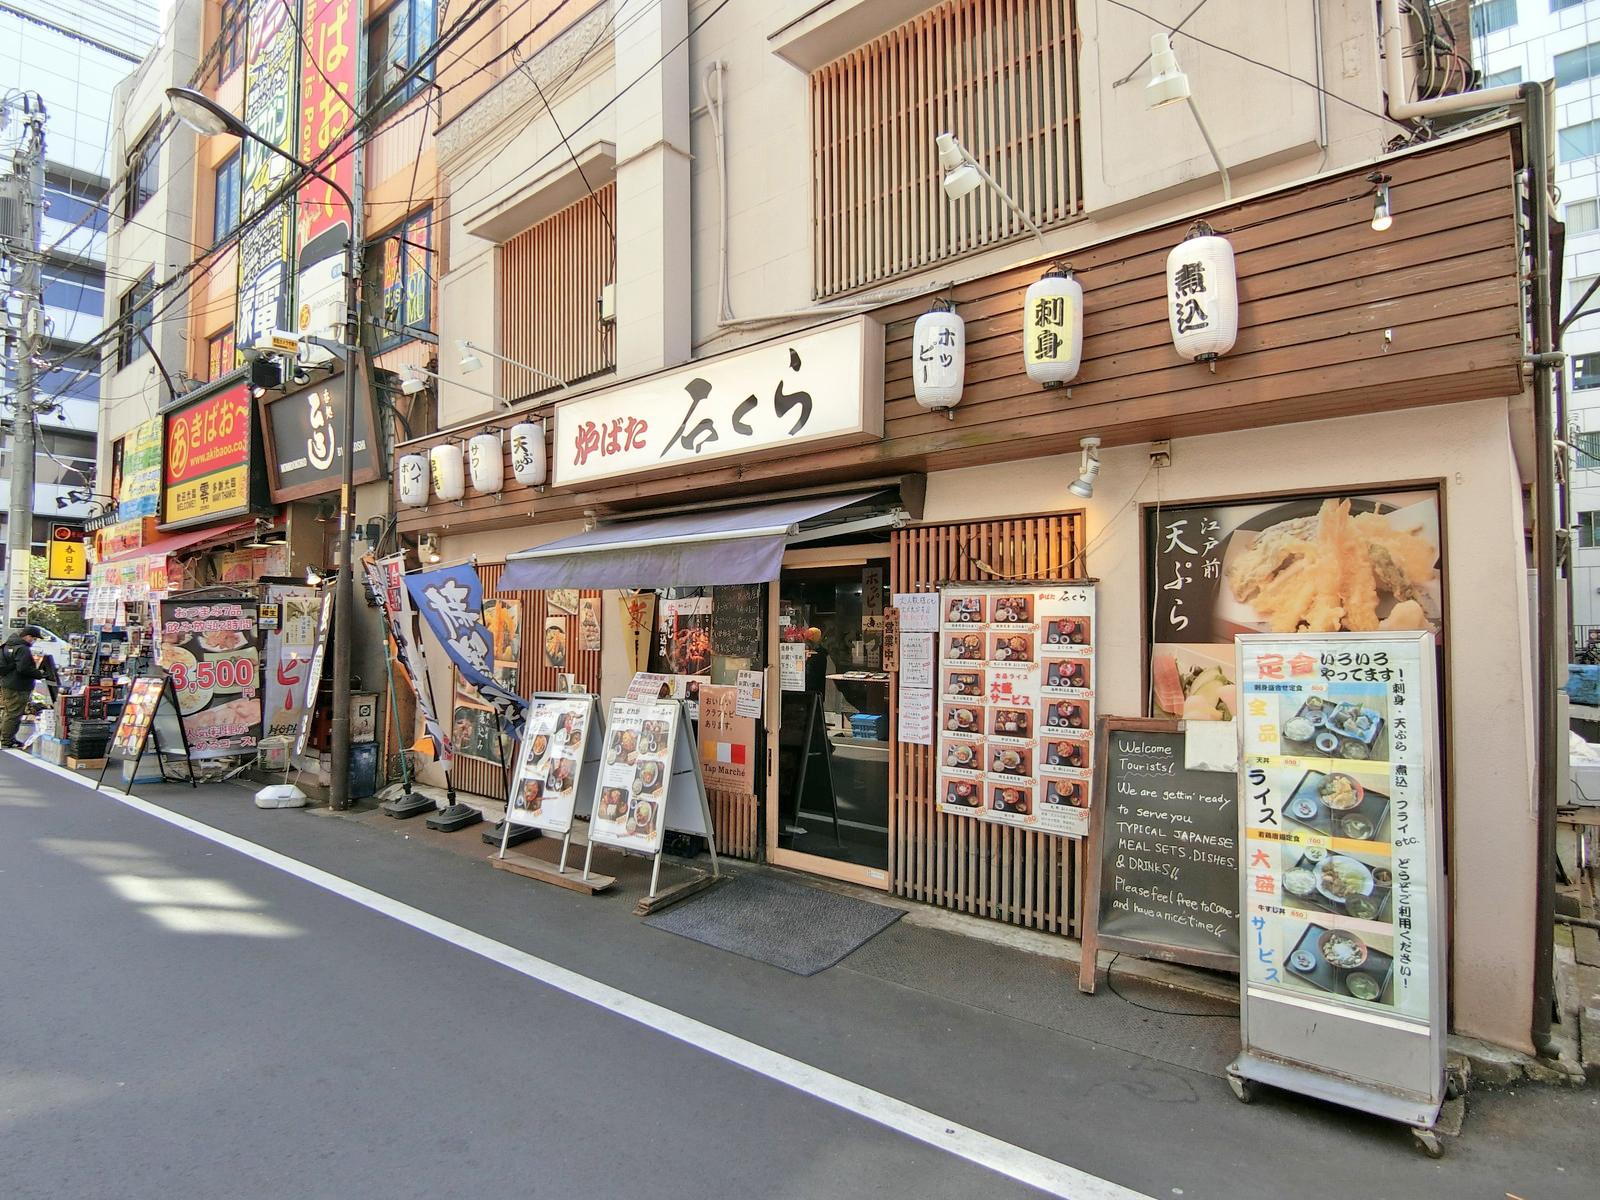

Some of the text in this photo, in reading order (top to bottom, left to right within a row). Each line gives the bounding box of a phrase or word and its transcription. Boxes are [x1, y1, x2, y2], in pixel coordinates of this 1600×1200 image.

[1174, 261, 1210, 335] 煮込
[1034, 296, 1065, 360] 刺身
[660, 347, 813, 459] 石くら
[470, 444, 480, 482] サワー
[512, 435, 533, 473] 天ぷら
[64, 545, 76, 575] 春日亭
[1200, 517, 1222, 579] 江戸前
[1163, 520, 1199, 632] 天ぷら
[174, 604, 244, 618] おつまみ7品
[165, 619, 253, 633] 飲み放題2時間
[1256, 652, 1319, 680] 定食
[1320, 652, 1389, 666] いろいろ
[169, 658, 254, 694] 3,500
[990, 681, 1013, 694] 大盛
[1254, 684, 1303, 692] 刺身盛合せ定食
[242, 686, 256, 698] 円
[990, 693, 1032, 706] サービス
[1247, 698, 1279, 743] 全品
[1118, 739, 1172, 755] Welcome
[704, 763, 746, 777] Tap Marché
[1119, 758, 1176, 774] Tourists!
[1117, 782, 1138, 797] We
[1140, 788, 1158, 798] are
[1198, 794, 1231, 811] ready
[1248, 769, 1278, 826] ライス
[1078, 809, 1090, 819] 89
[1117, 804, 1193, 827] to serve you
[1116, 822, 1234, 849] TYPICAL JAPANESE
[1118, 838, 1151, 853] MEAL
[1307, 837, 1321, 845] 700
[1115, 855, 1125, 869] &
[1250, 848, 1276, 895] 大盛
[1115, 876, 1150, 898] Please
[1150, 885, 1174, 905] feel
[1176, 893, 1198, 910] free
[1112, 899, 1130, 912] and
[1133, 902, 1155, 917] have
[1156, 911, 1163, 919] a
[1257, 904, 1286, 916] 牛すじ丼
[1251, 916, 1281, 984] サービス
